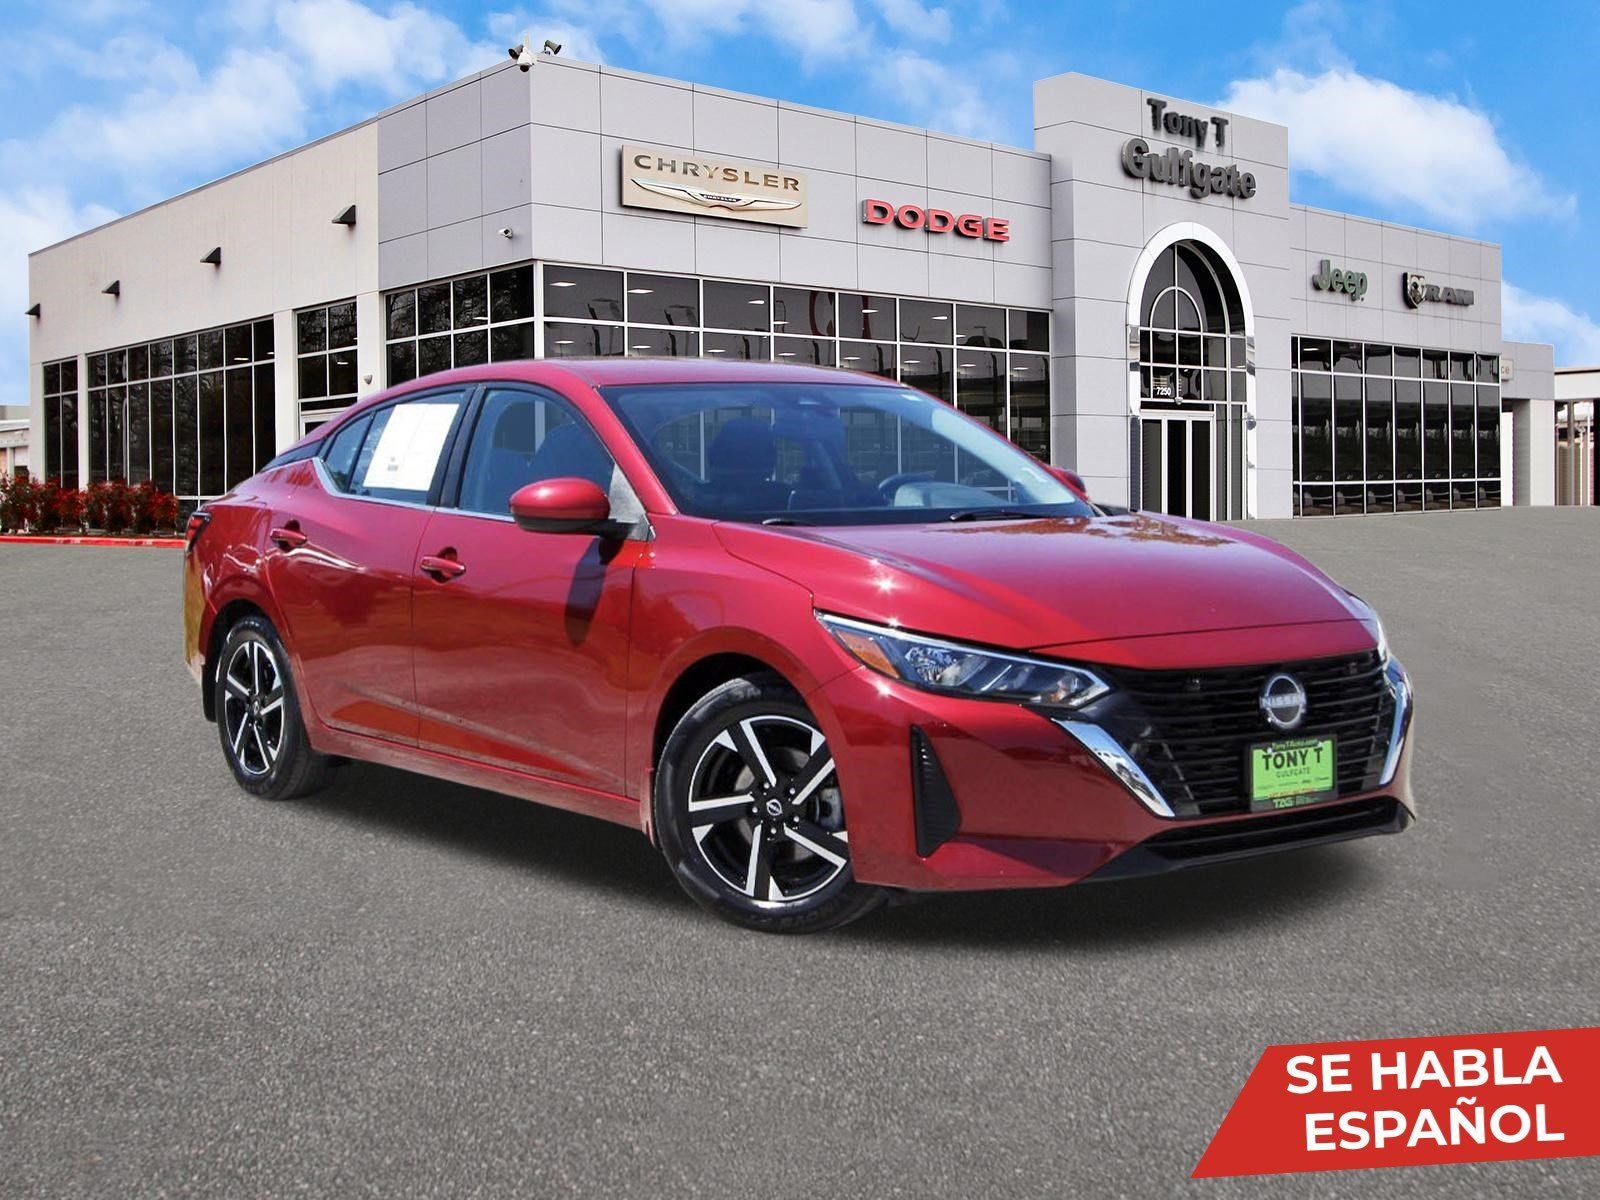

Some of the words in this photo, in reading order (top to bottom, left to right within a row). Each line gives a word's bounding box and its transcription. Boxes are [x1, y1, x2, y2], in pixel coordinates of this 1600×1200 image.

[1147, 98, 1208, 148] Tony
[1210, 116, 1229, 147] T
[634, 154, 800, 191] CHRYSLER
[1121, 138, 1257, 199] Gulfgate
[863, 199, 1010, 242] DODGE
[1313, 259, 1368, 301] Jeep
[1425, 283, 1475, 307] RAM
[1156, 386, 1172, 396] 7250
[1262, 749, 1309, 771] TONY
[1313, 747, 1323, 763] T
